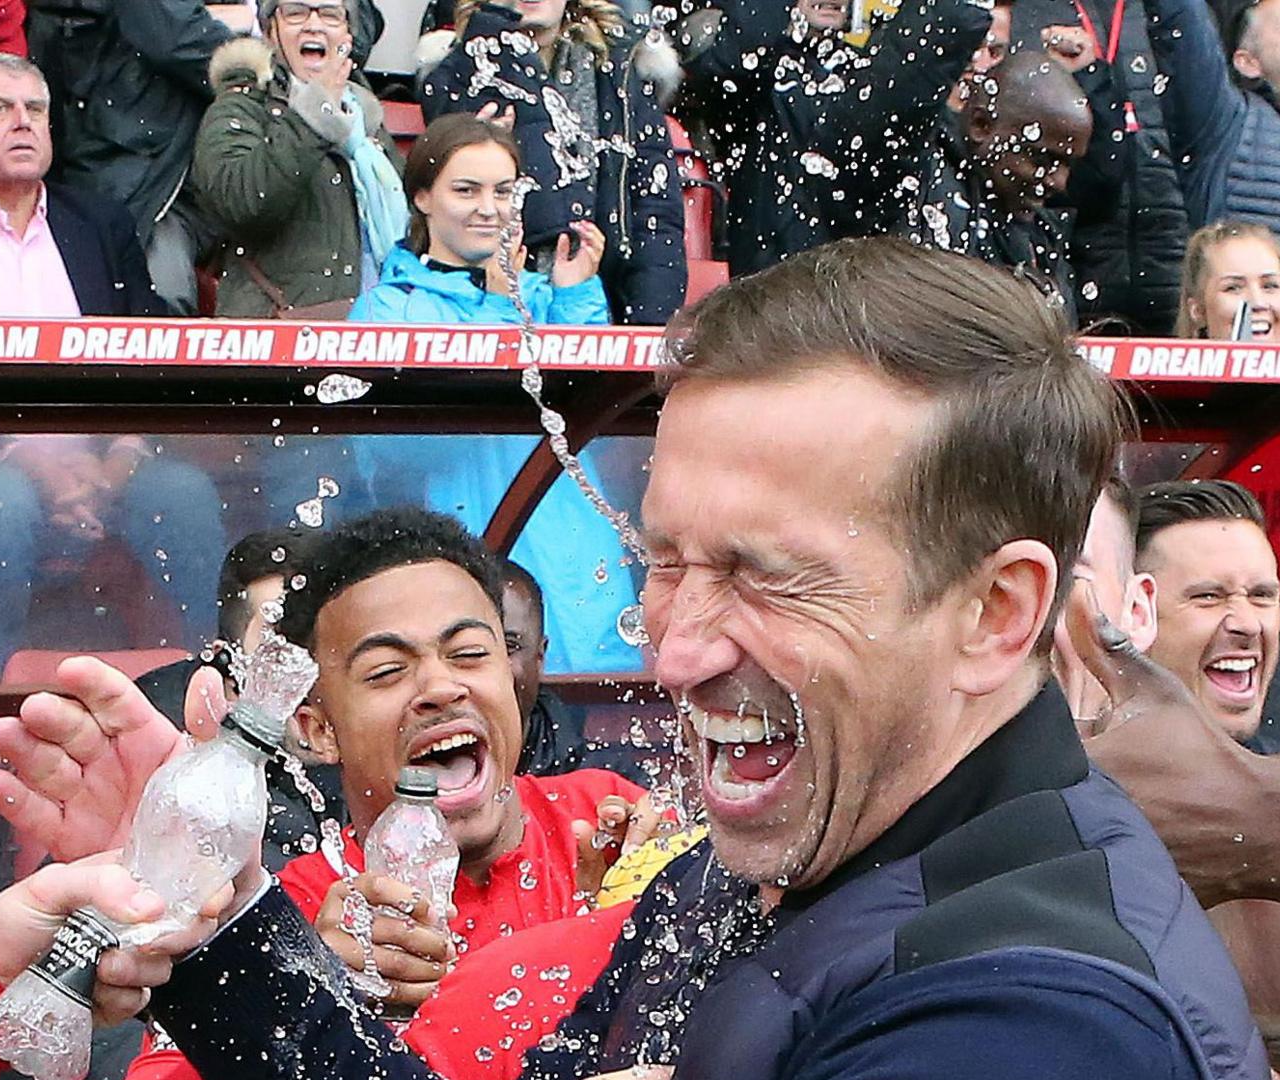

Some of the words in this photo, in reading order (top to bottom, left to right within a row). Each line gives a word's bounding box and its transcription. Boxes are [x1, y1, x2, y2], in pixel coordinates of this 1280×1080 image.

[58, 326, 180, 360] DREAM
[185, 329, 274, 361] TEAM
[294, 330, 410, 362] DREAM
[413, 332, 500, 363] TEAM
[518, 333, 629, 365] DREAM
[1129, 347, 1224, 377] DREAM
